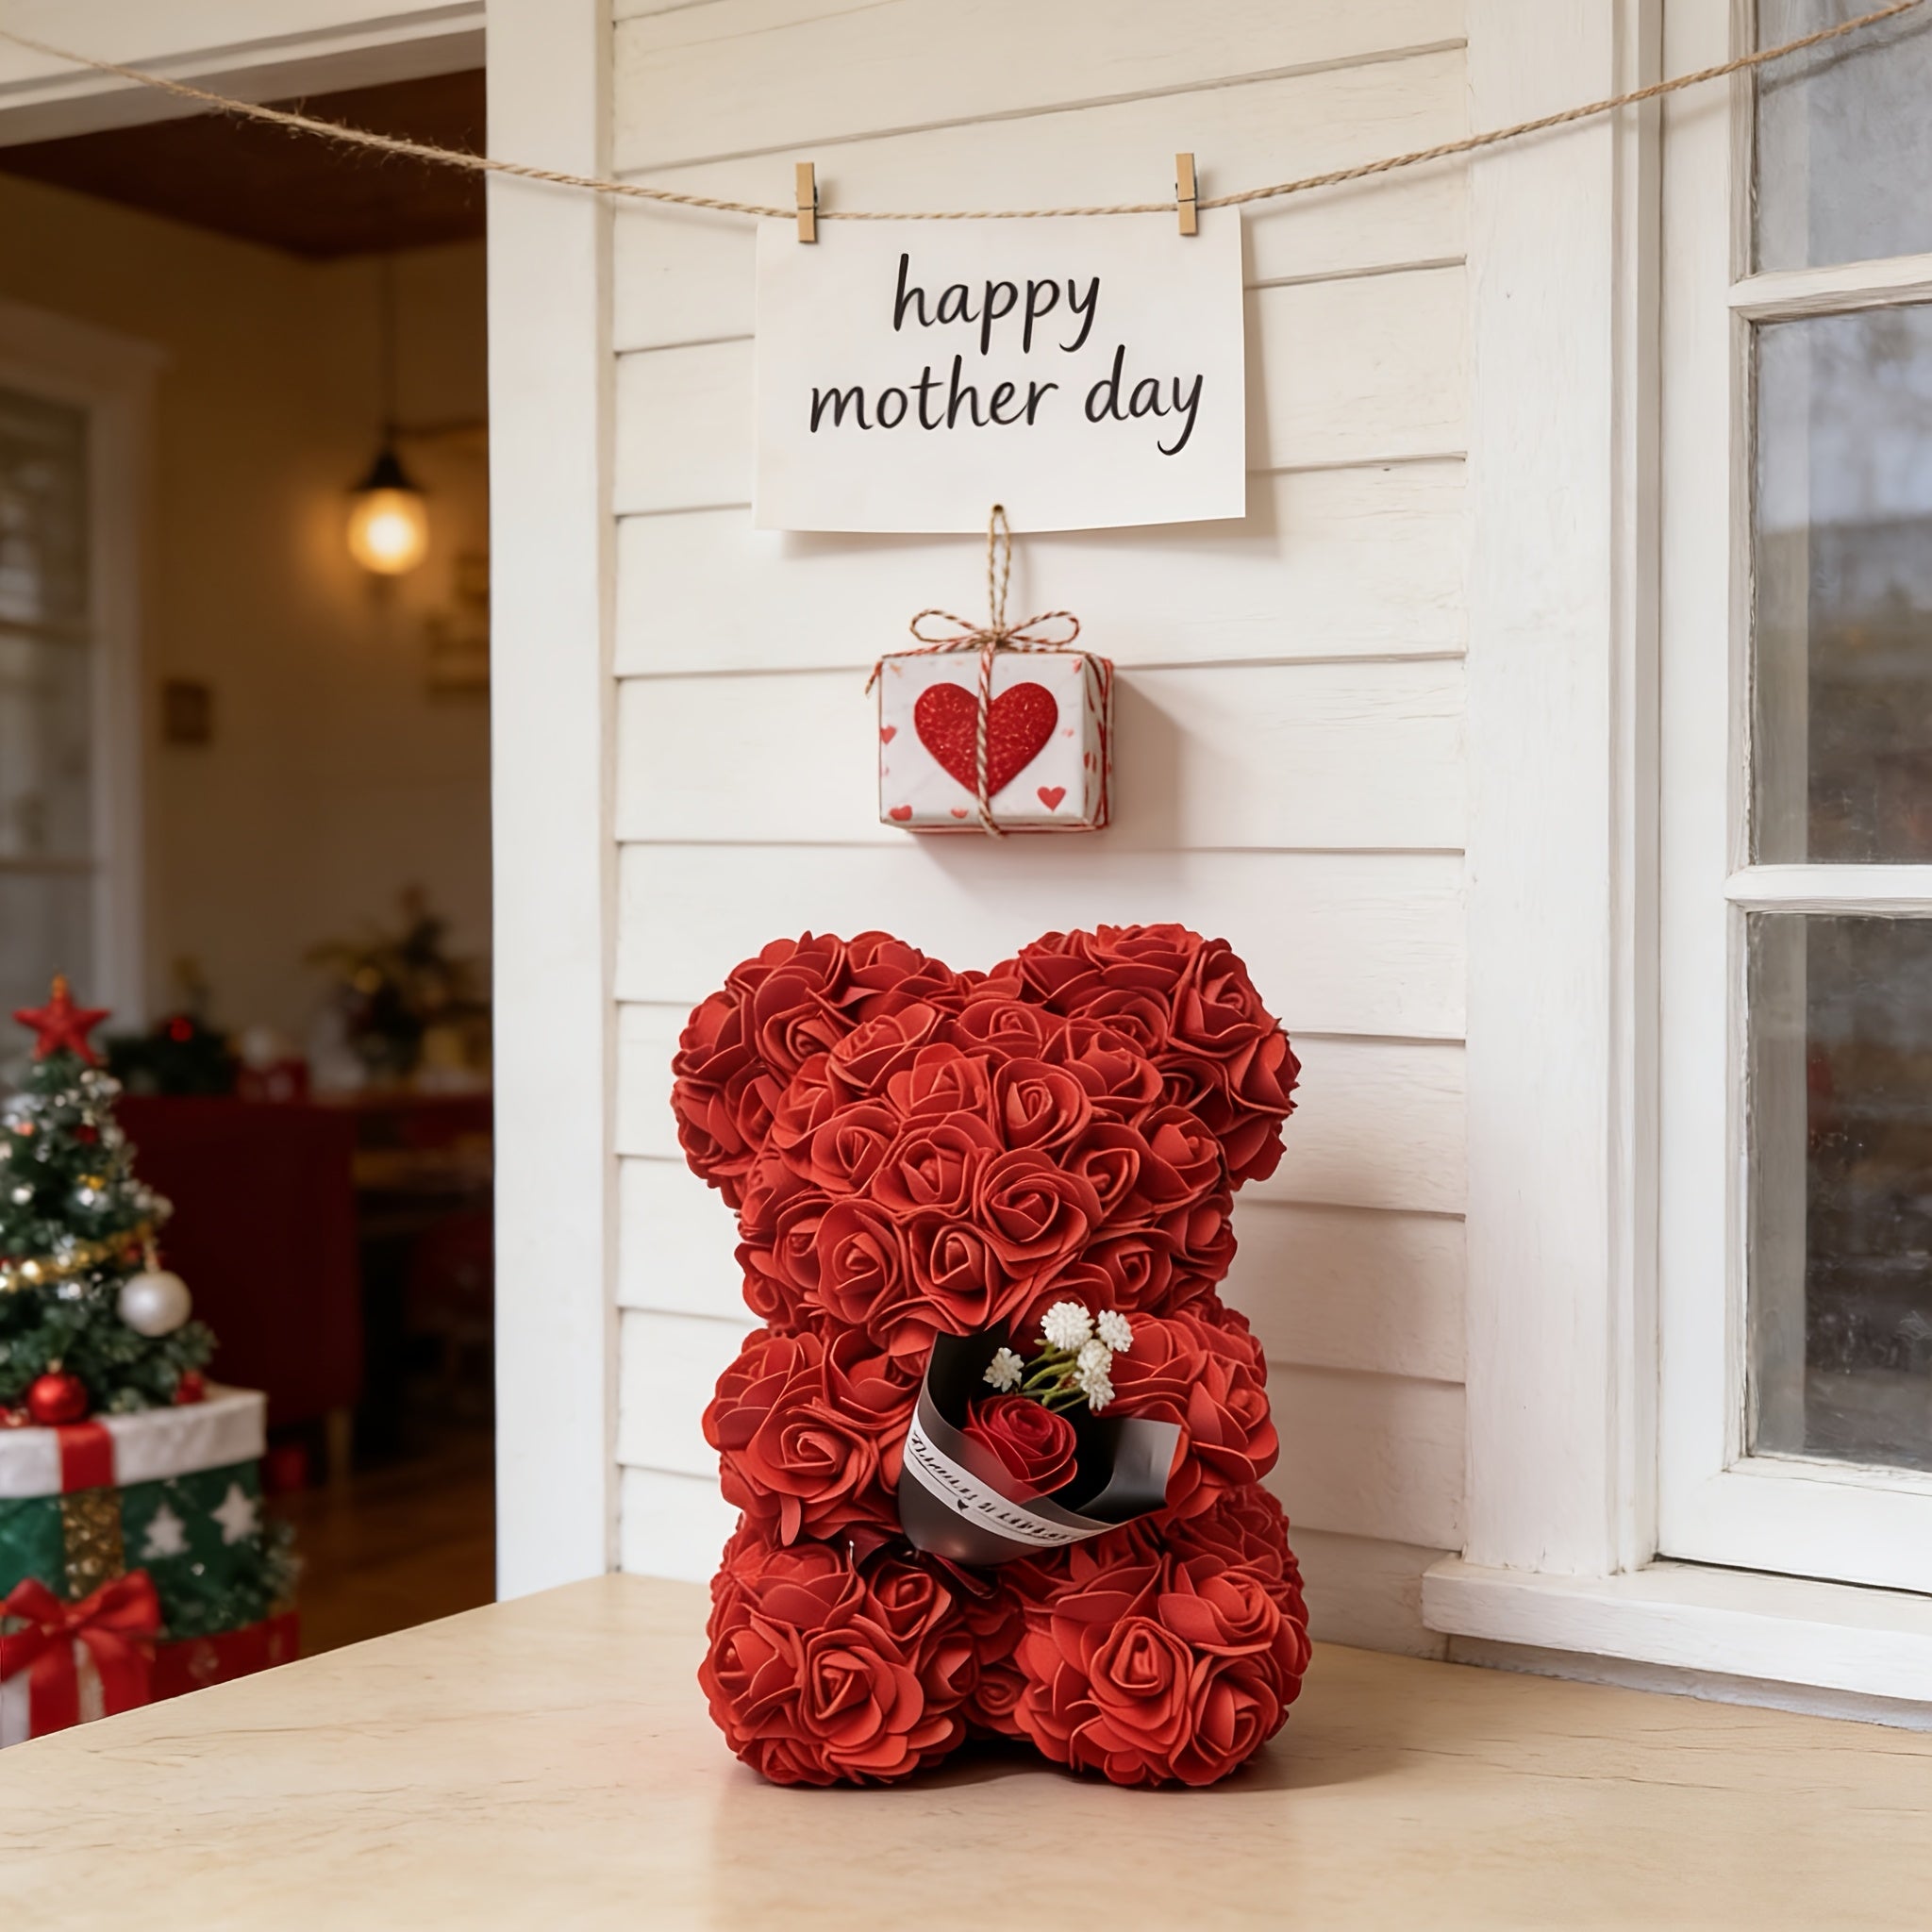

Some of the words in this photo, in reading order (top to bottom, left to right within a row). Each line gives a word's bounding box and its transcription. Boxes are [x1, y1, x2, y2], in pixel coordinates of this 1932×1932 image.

[892, 252, 1101, 357] happy
[809, 354, 1059, 433] mother
[1083, 342, 1205, 458] day
